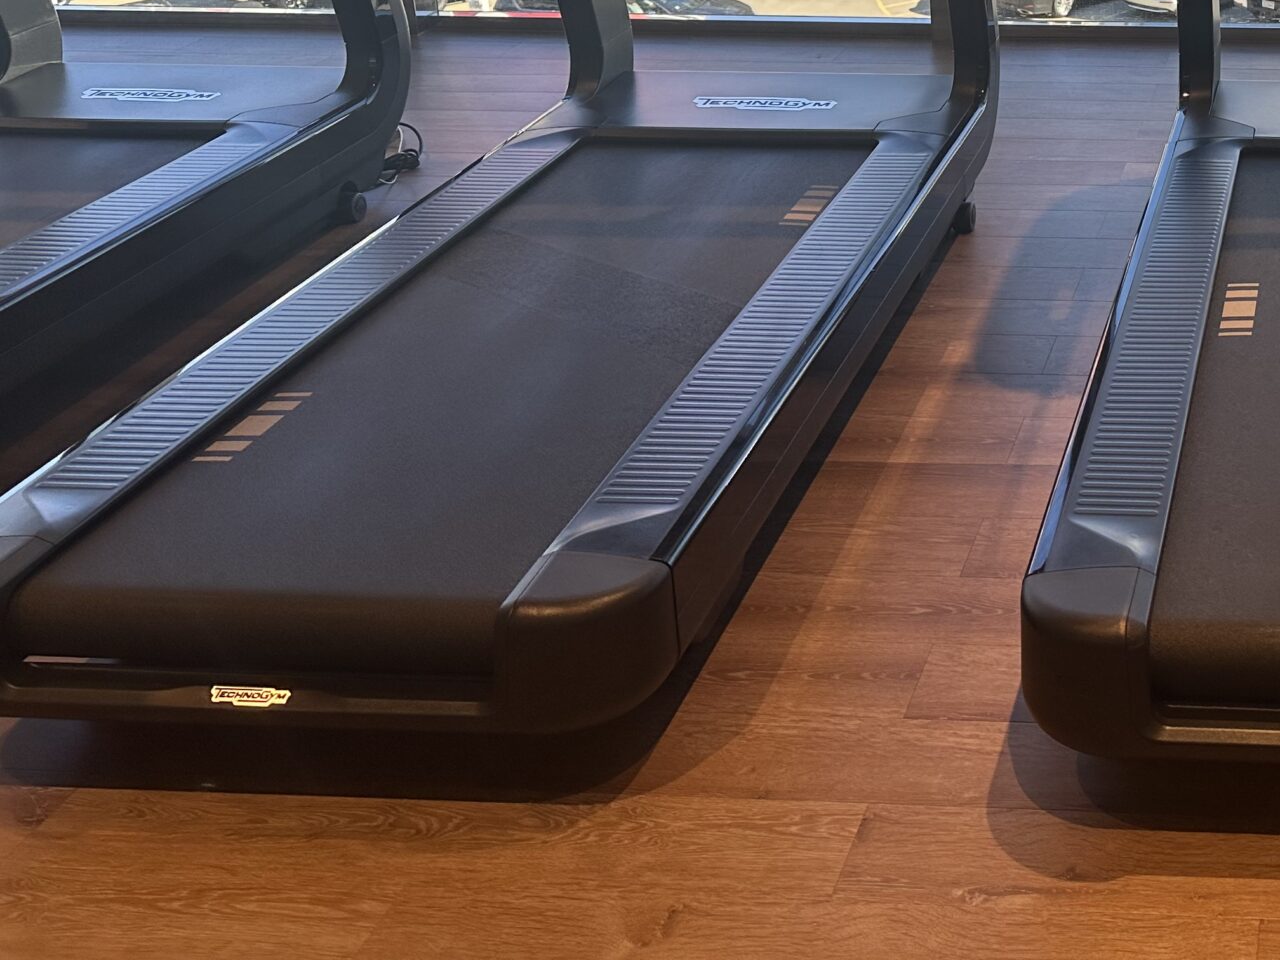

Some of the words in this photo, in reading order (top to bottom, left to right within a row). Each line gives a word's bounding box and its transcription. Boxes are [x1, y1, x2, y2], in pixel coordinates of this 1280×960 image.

[87, 88, 216, 100] TECHNOGYM
[697, 97, 832, 109] TECHNOGYM
[213, 687, 287, 703] TECHNOGYM
